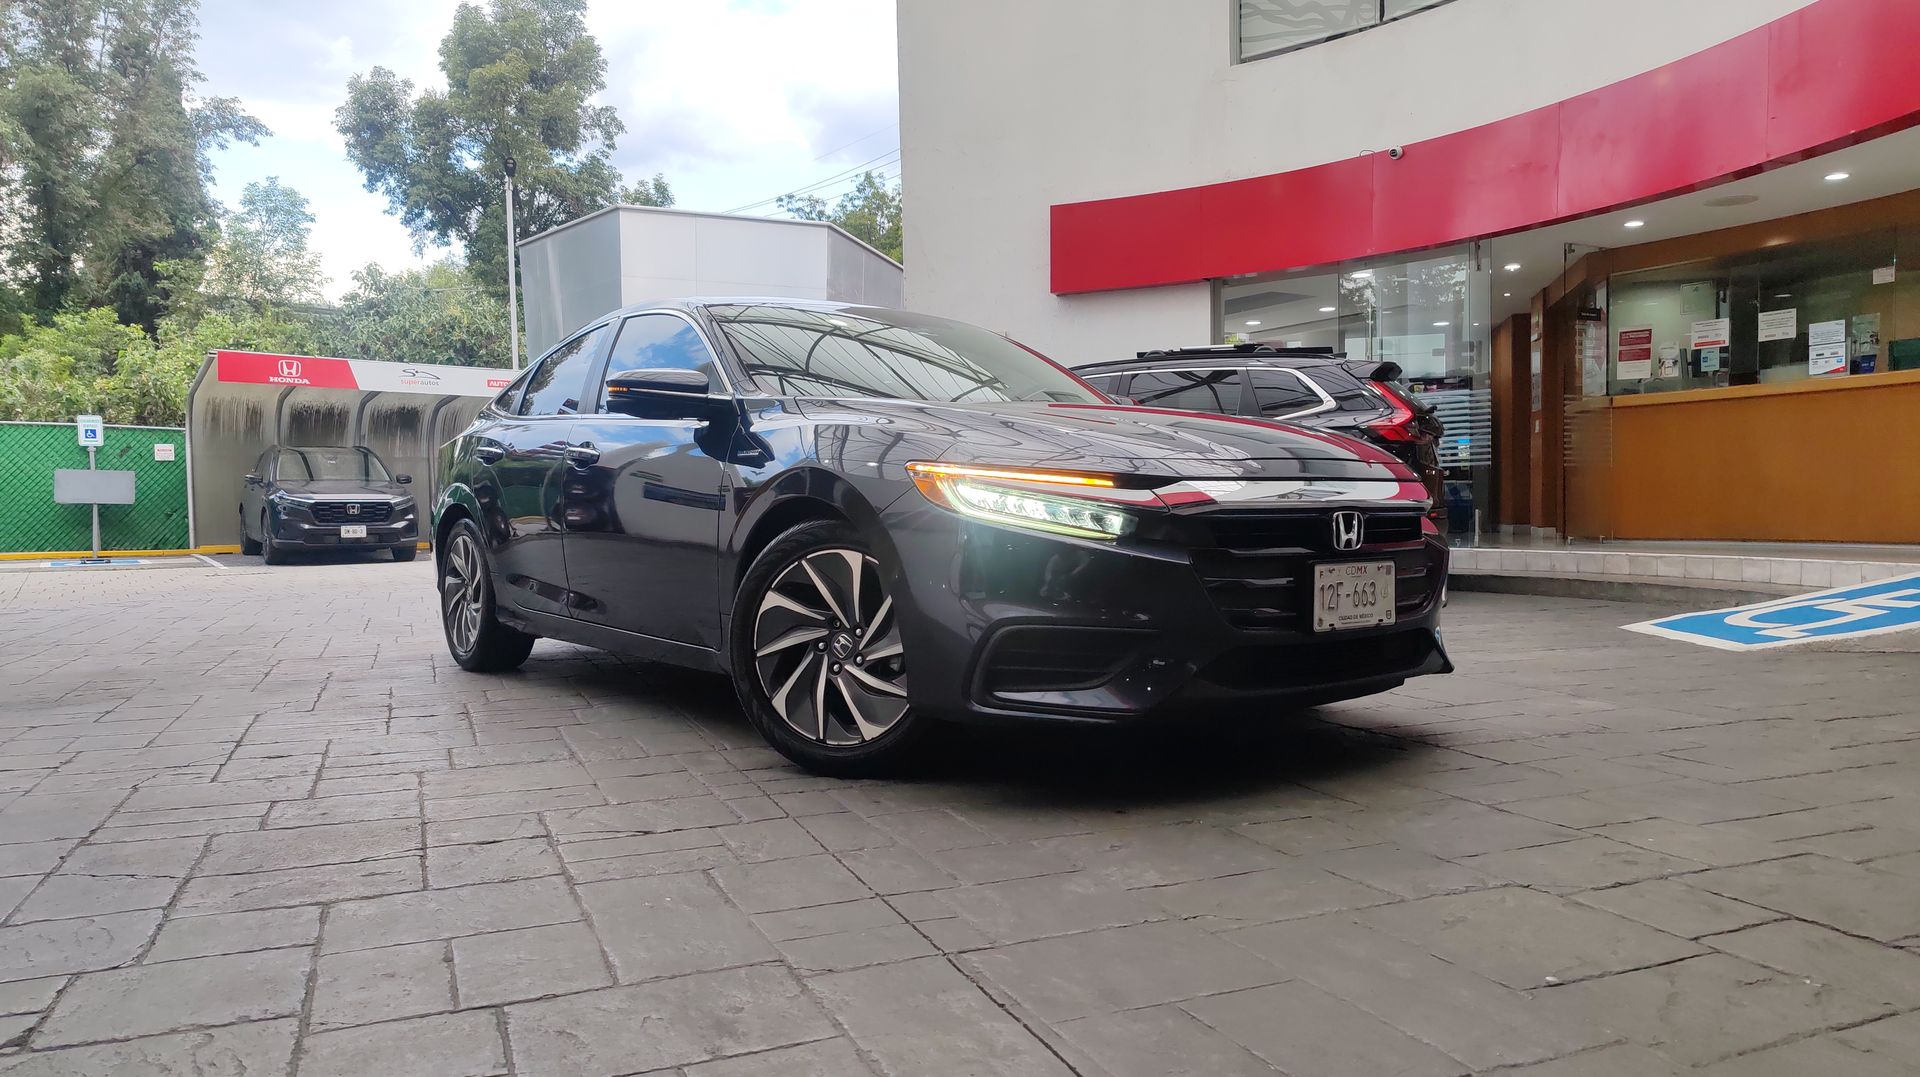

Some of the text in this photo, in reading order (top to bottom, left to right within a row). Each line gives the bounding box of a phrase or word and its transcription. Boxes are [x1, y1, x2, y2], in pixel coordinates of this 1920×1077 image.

[269, 376, 311, 384] HONDA
[1345, 565, 1368, 576] CDMX
[1320, 581, 1377, 611] 12F-663
